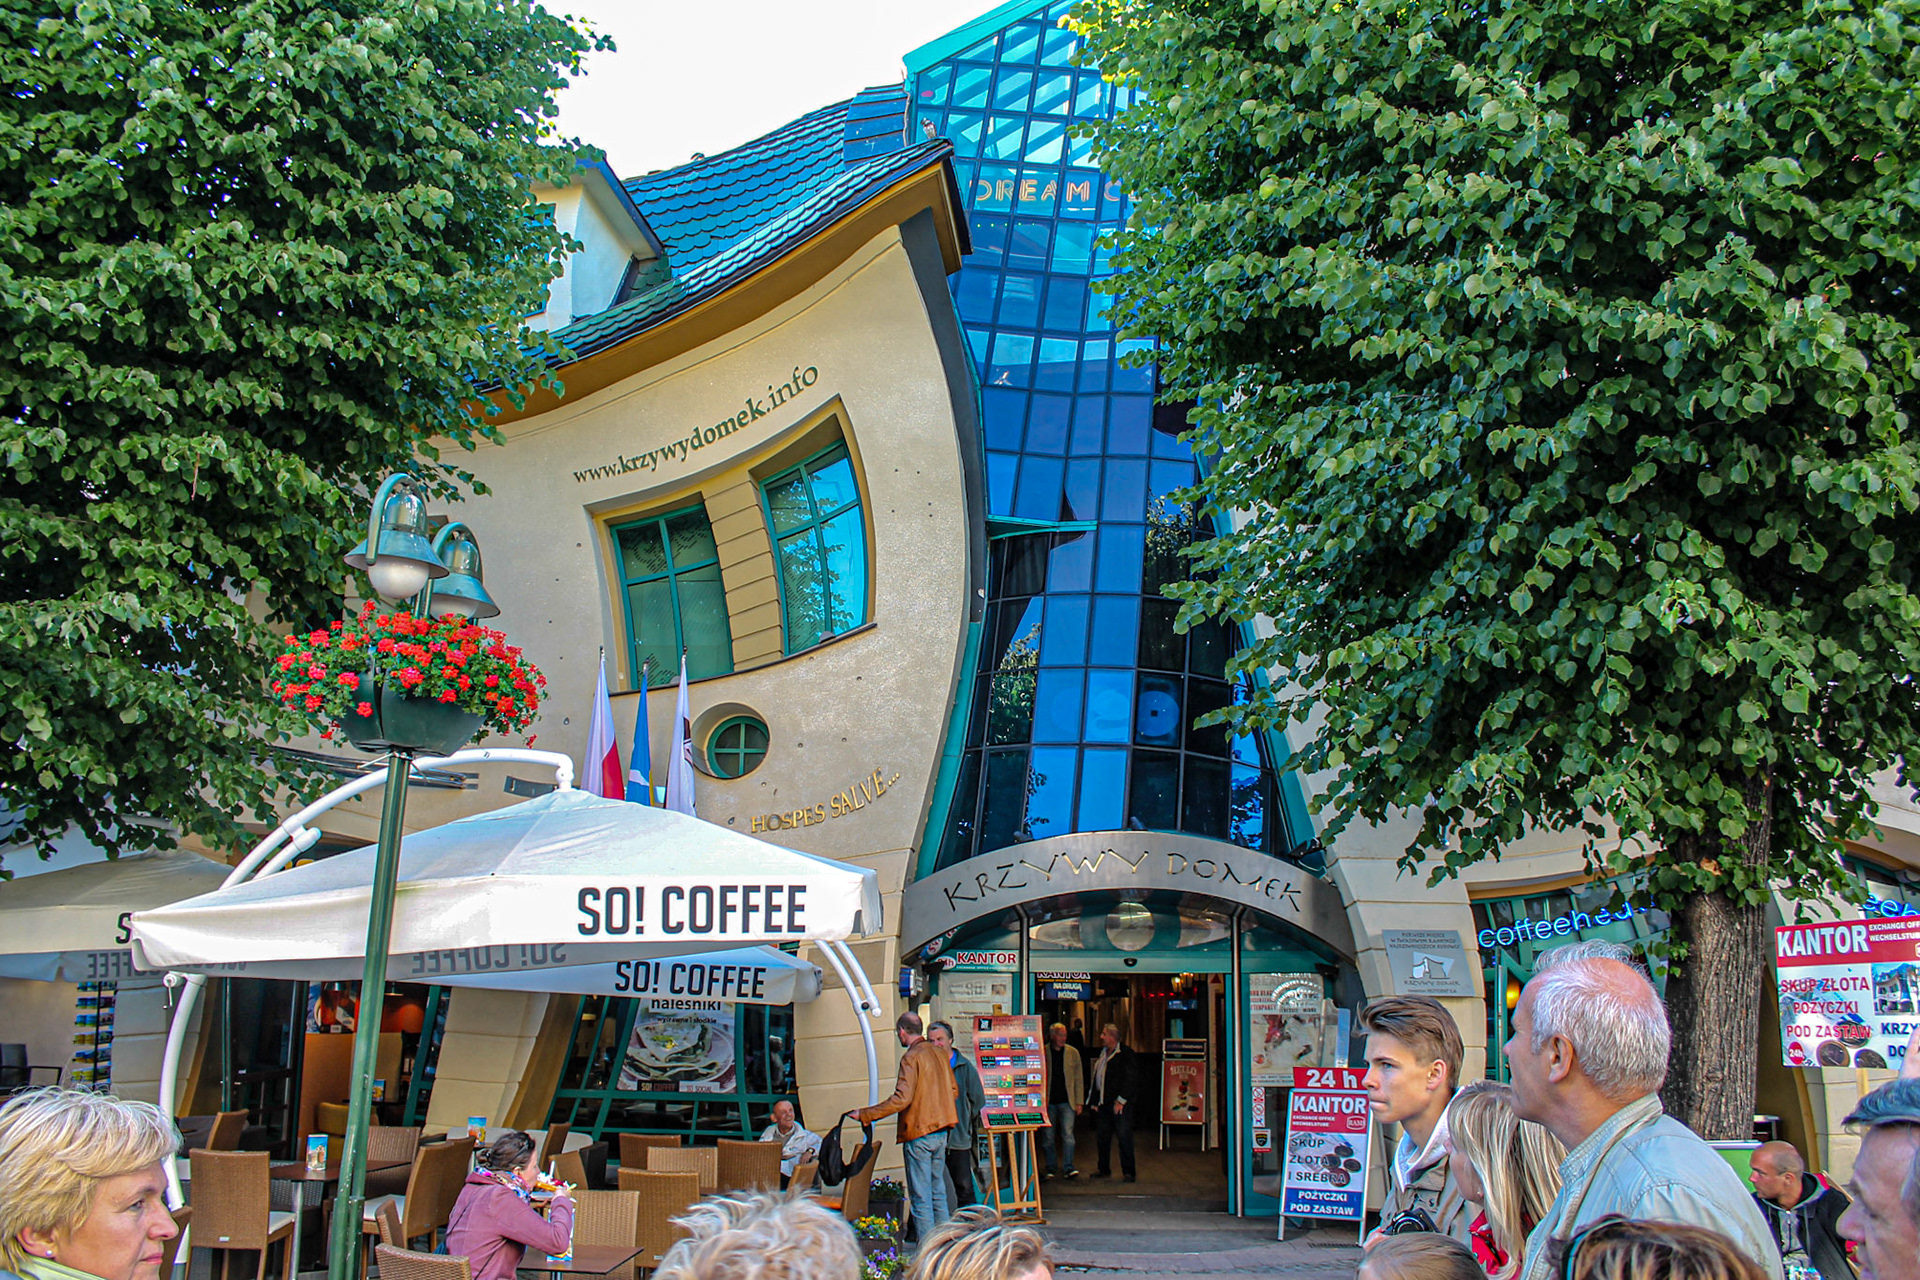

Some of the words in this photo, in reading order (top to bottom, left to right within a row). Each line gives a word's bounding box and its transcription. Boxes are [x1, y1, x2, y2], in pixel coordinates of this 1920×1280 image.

[970, 179, 1090, 202] DREAM
[573, 365, 819, 483] www.krzywydomek.info
[751, 803, 826, 833] HOSPES
[943, 848, 1149, 912] KRZYWY
[1166, 852, 1302, 912] DOMEK
[578, 886, 645, 935] SO!
[661, 885, 806, 934] COFFEE
[1777, 925, 1870, 957] KANTOR
[1869, 922, 1905, 931] EXCHANGE
[957, 952, 1017, 965] KANTOR
[615, 961, 660, 993] SO!
[669, 963, 767, 999] COFFEE
[1781, 979, 1817, 993] SKUP
[1821, 977, 1870, 991] ZŁOTA
[1786, 1025, 1811, 1037] POD
[1815, 1025, 1872, 1038] ZASTAW
[1881, 1022, 1920, 1035] KRZY
[1789, 1048, 1804, 1058] 24h
[1888, 1045, 1907, 1058] DO
[1306, 1069, 1336, 1088] 24
[1342, 1070, 1358, 1088] h
[1293, 1095, 1367, 1114] KANTOR
[1291, 1138, 1325, 1148] SKUP
[1289, 1155, 1329, 1165] ZŁOTA
[1288, 1171, 1292, 1180] I
[1296, 1172, 1346, 1183] SREBRA
[1298, 1190, 1348, 1202] POŻYCZKI
[1290, 1203, 1311, 1212] POD
[1312, 1204, 1354, 1215] ZASTAW
